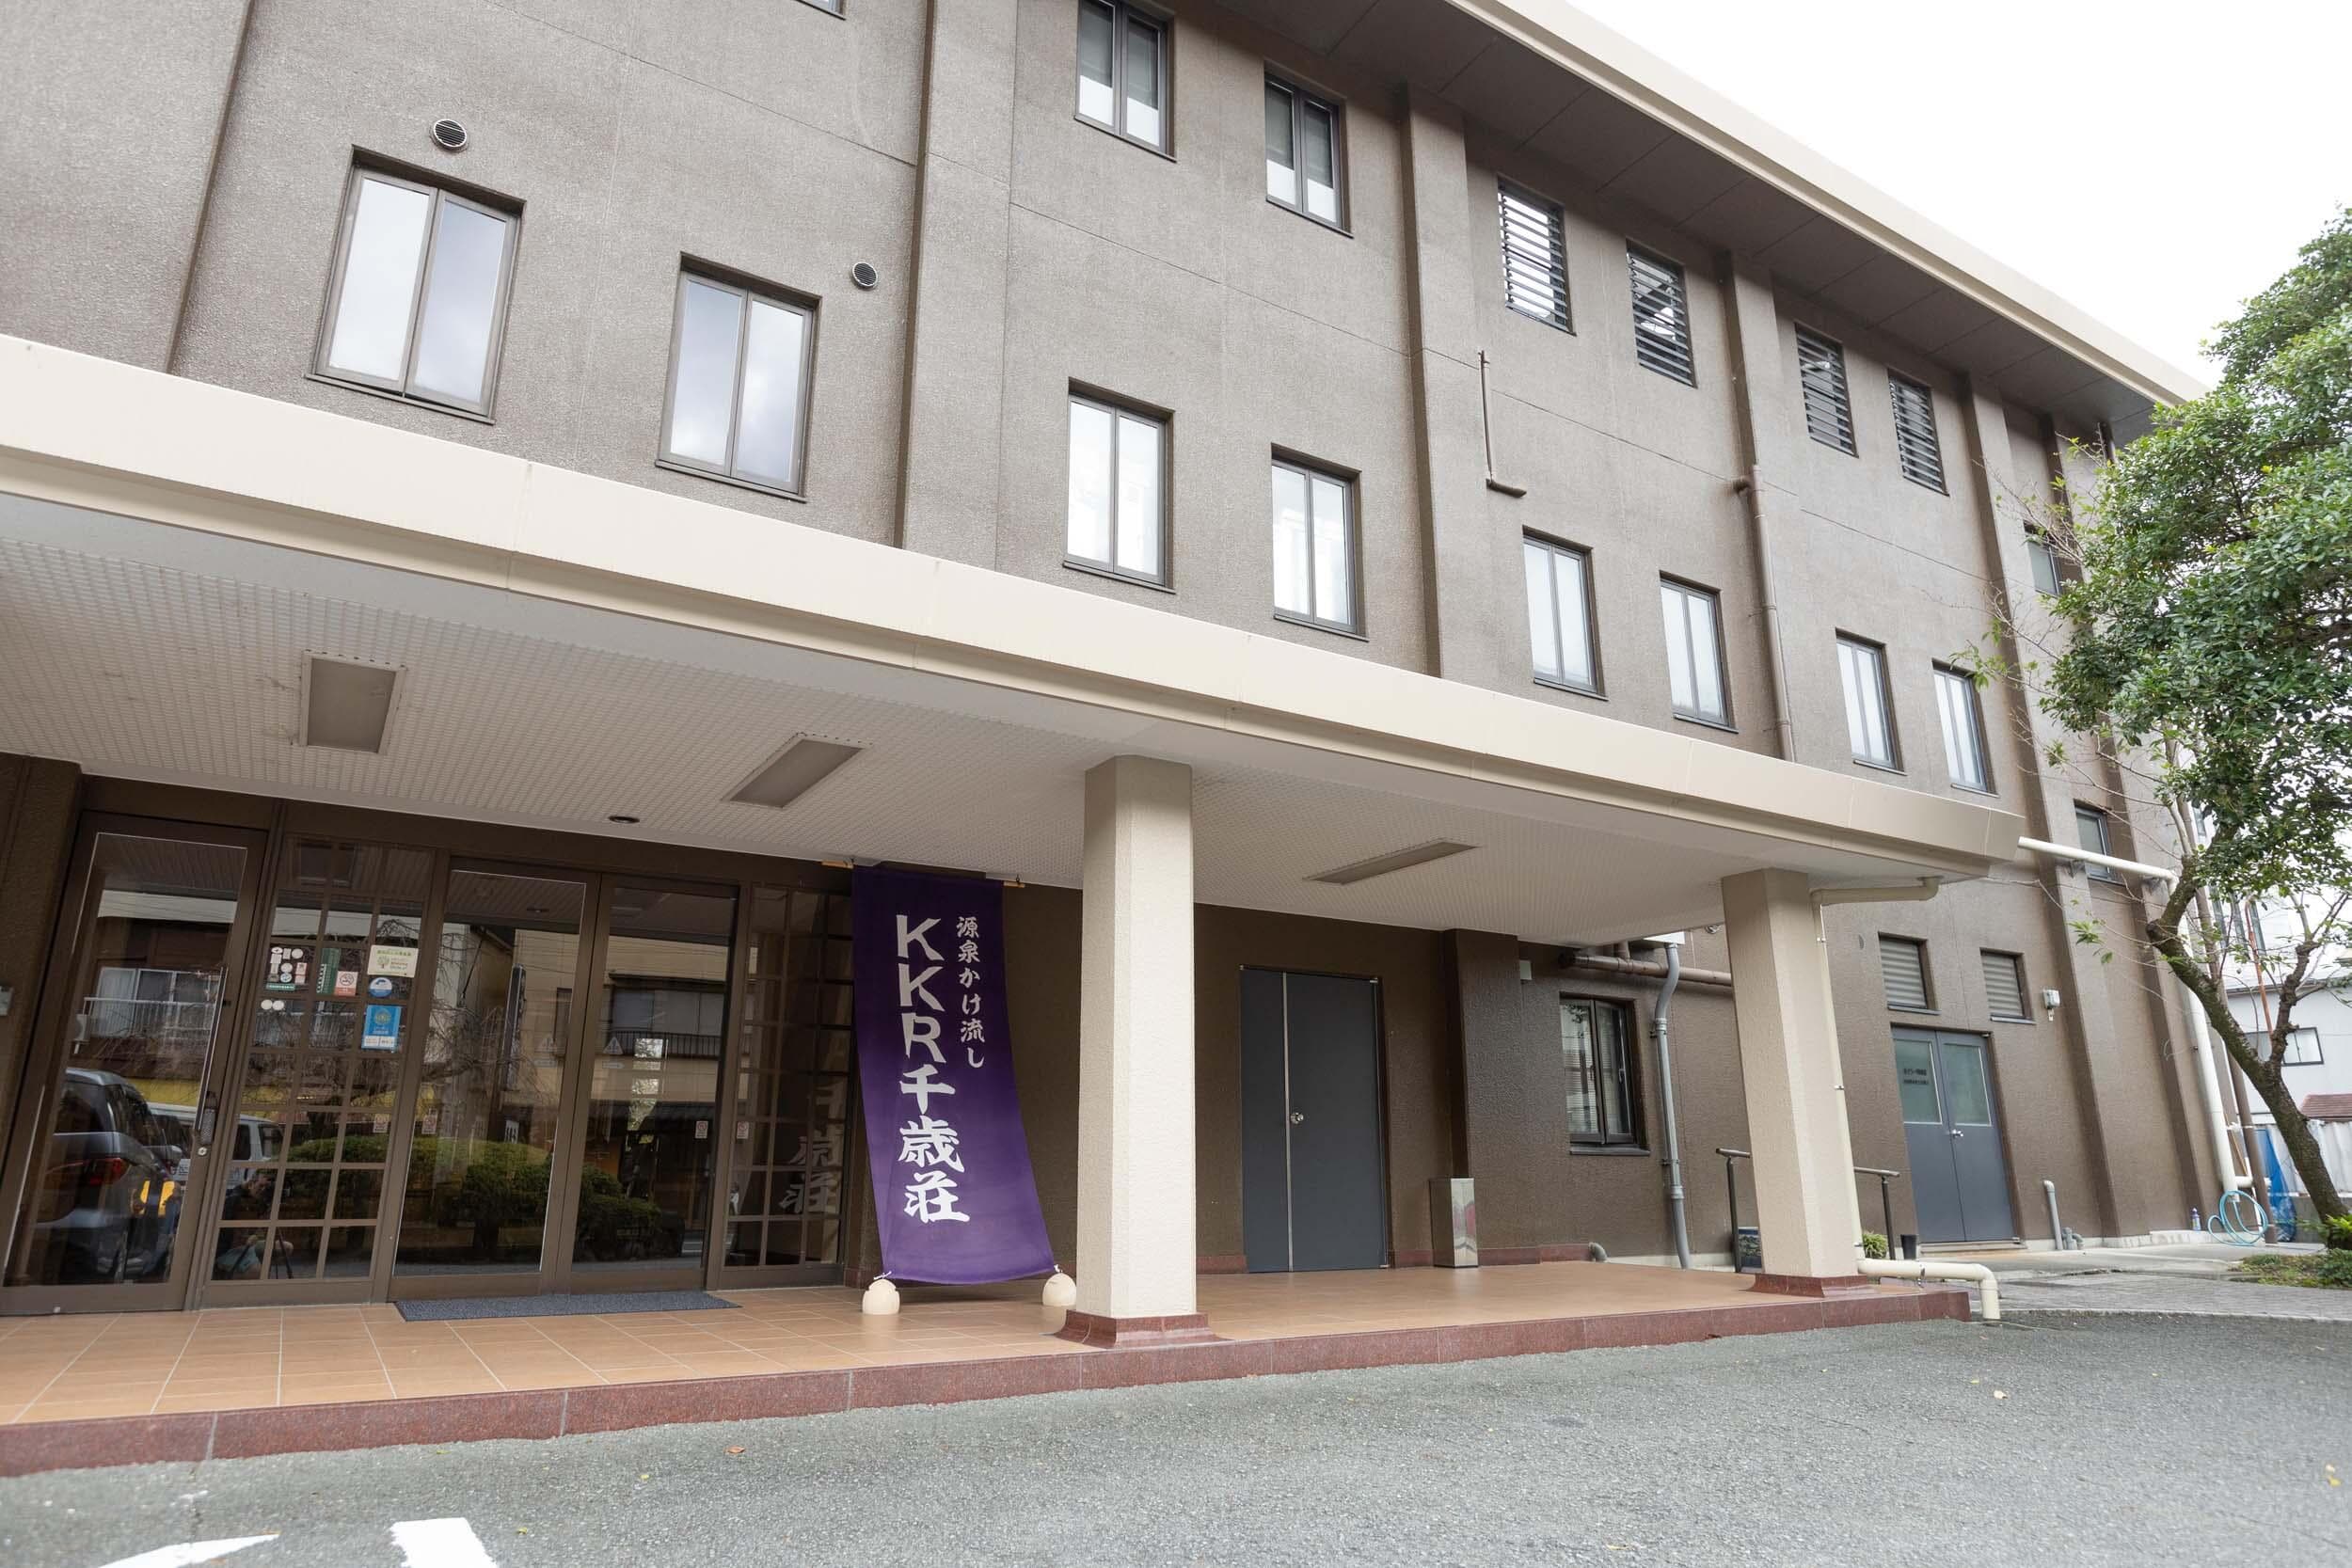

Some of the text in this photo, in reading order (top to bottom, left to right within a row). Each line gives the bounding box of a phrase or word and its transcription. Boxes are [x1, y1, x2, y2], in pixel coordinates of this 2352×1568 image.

[896, 914, 970, 1225] KKR千歳荘
[956, 915, 986, 1069] 源泉かけ流し
